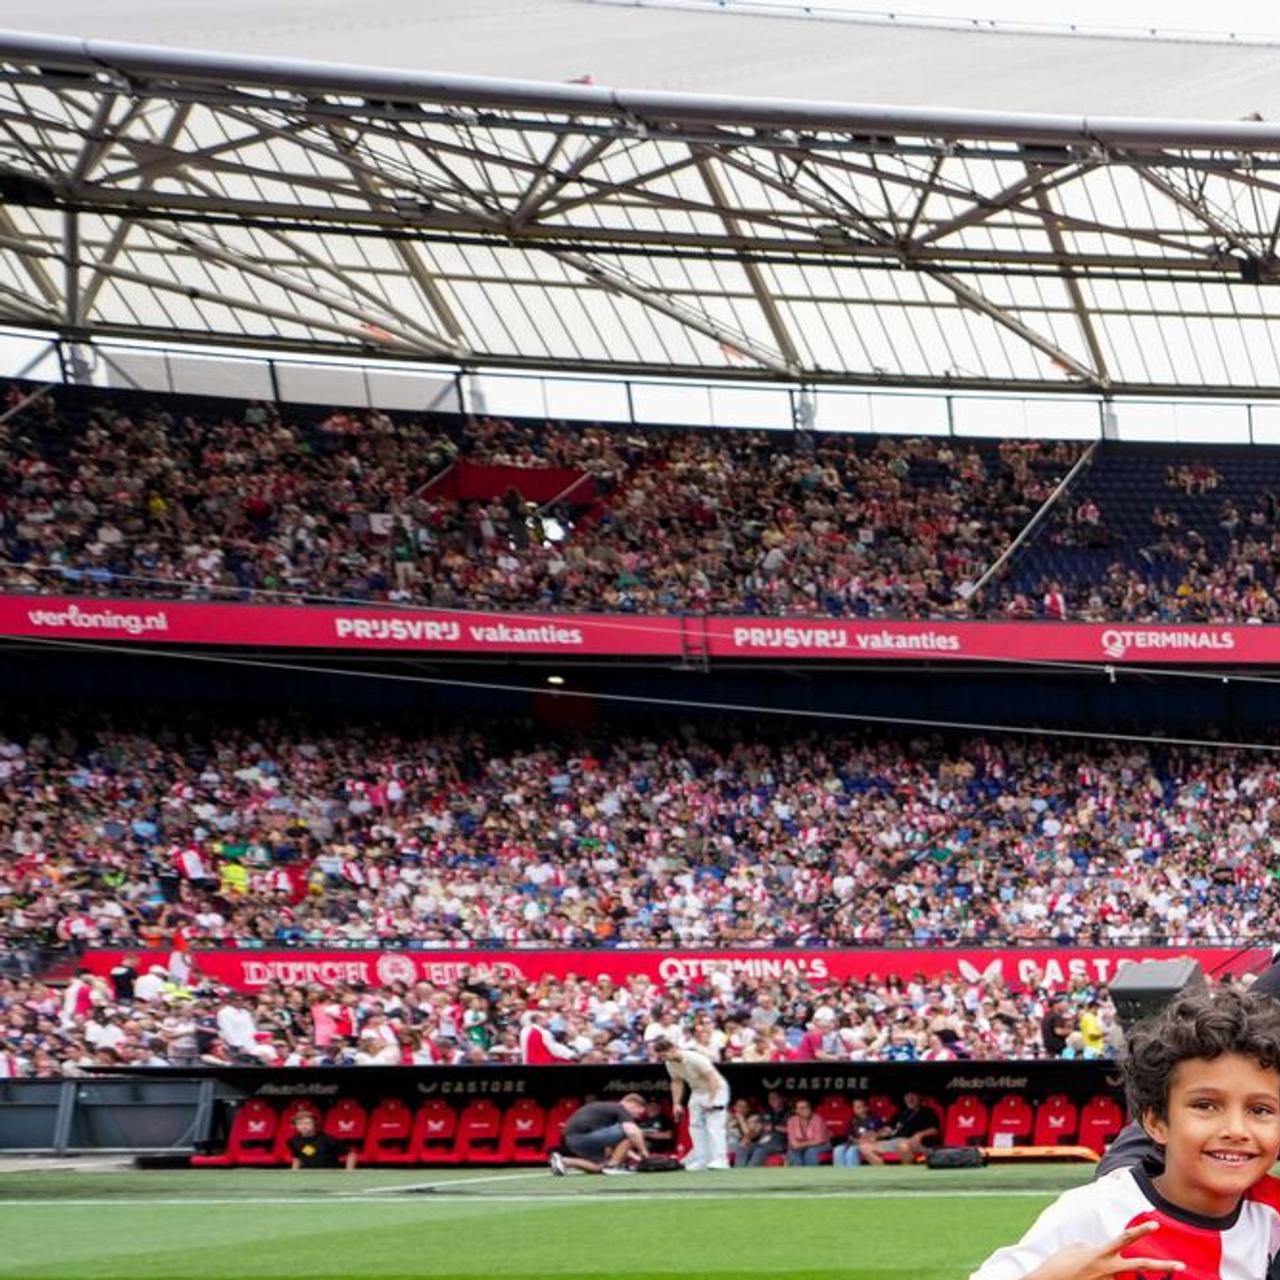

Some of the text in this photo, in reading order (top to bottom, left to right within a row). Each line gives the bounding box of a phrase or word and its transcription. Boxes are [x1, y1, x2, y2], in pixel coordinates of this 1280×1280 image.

[28, 605, 168, 634] verloning.nl
[471, 622, 583, 645] vakanties
[856, 632, 960, 651] vakanties
[441, 1080, 526, 1093] CASTORE
[785, 1077, 869, 1090] CASTORE
